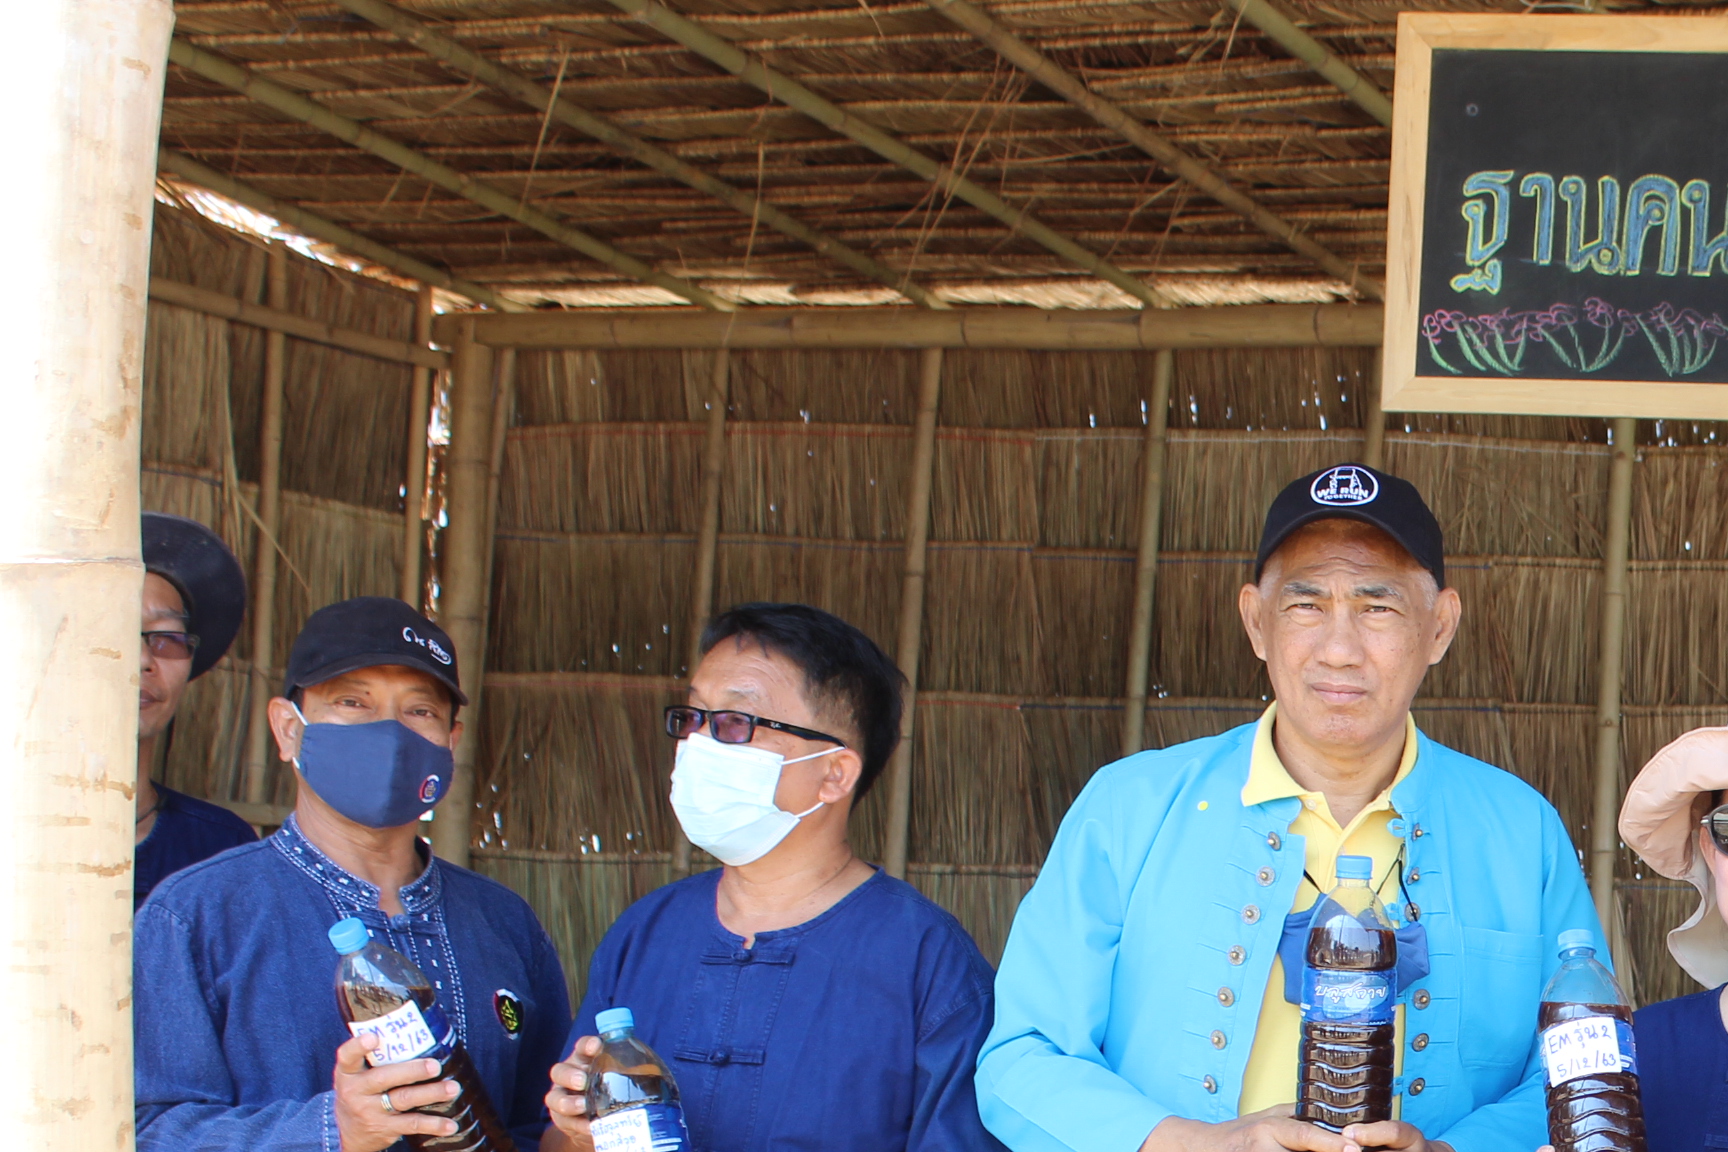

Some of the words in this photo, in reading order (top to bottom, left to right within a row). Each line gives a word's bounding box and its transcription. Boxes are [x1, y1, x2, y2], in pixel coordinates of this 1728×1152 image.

[1317, 488, 1338, 498] WE
[1340, 487, 1369, 498] RUN
[1323, 493, 1363, 501] TOGETHER
[1548, 1033, 1572, 1055] EM
[1556, 1049, 1617, 1078] 5/12/63
